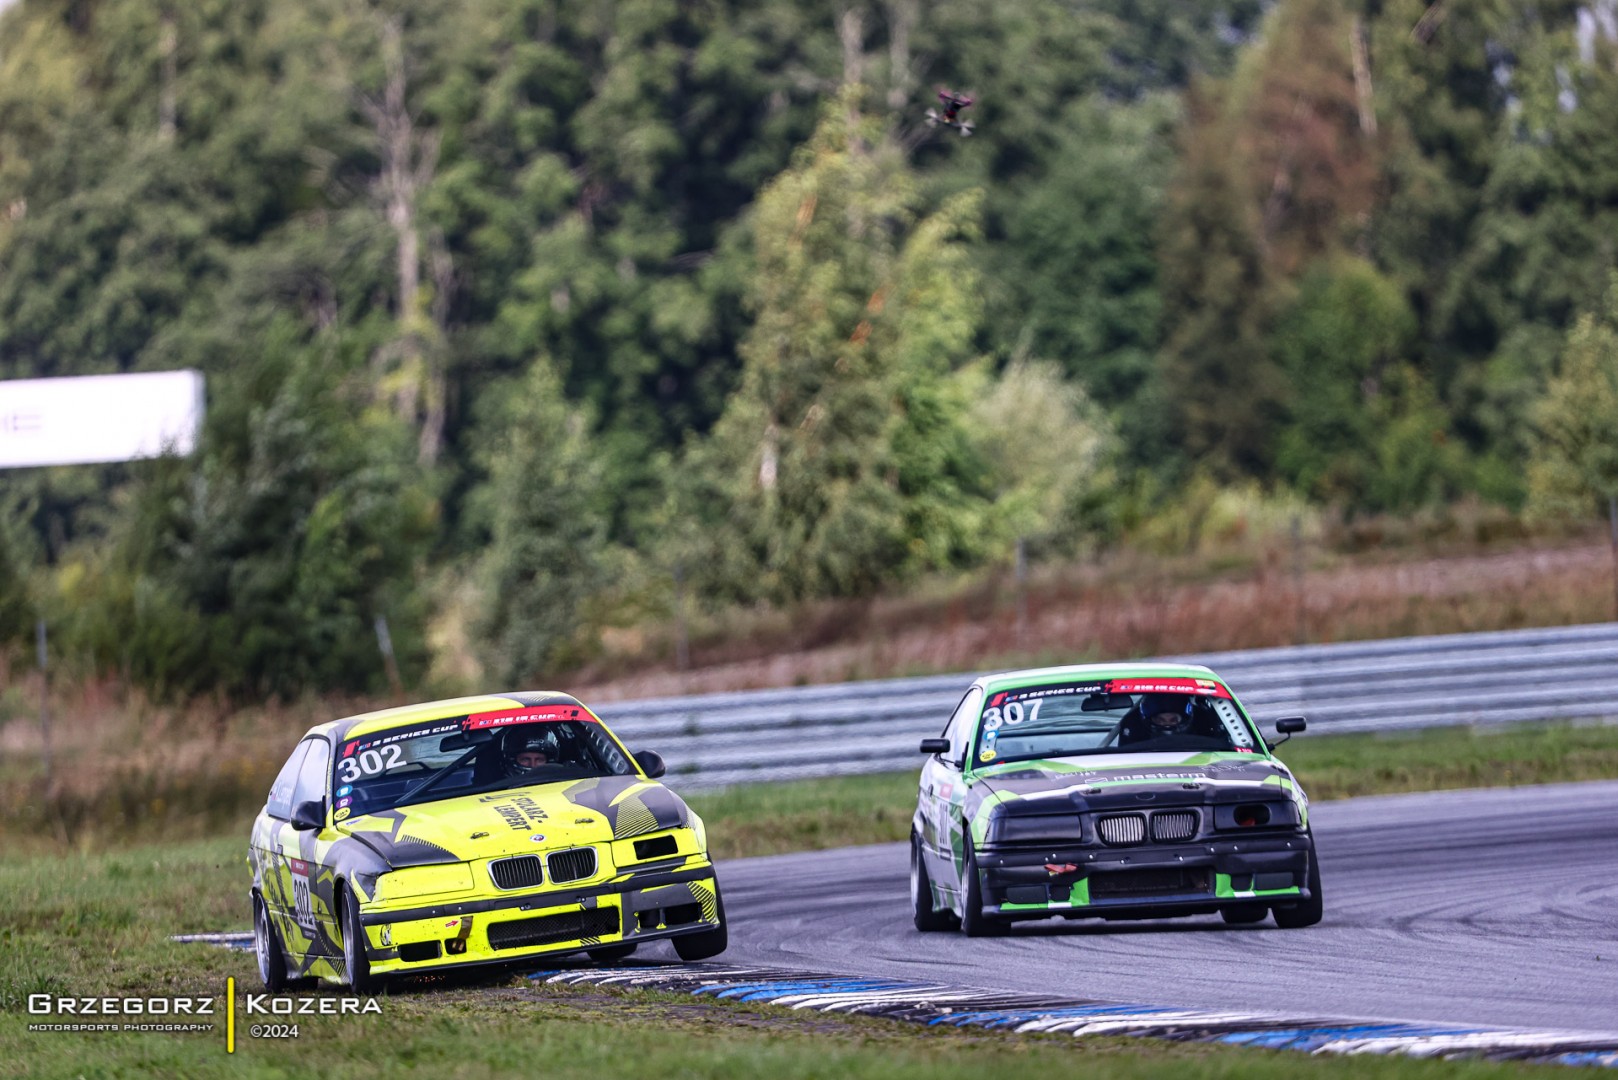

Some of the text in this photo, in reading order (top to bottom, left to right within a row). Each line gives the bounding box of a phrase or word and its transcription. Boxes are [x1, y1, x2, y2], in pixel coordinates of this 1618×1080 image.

[1029, 687, 1074, 698] SERIES
[1075, 686, 1101, 694] CUP
[530, 713, 556, 721] CUP
[982, 698, 1043, 731] 307
[383, 729, 430, 744] SERIES
[432, 724, 458, 734] CUP
[337, 744, 407, 783] 302
[494, 804, 532, 831] LEMPERT
[293, 878, 314, 926] 302
